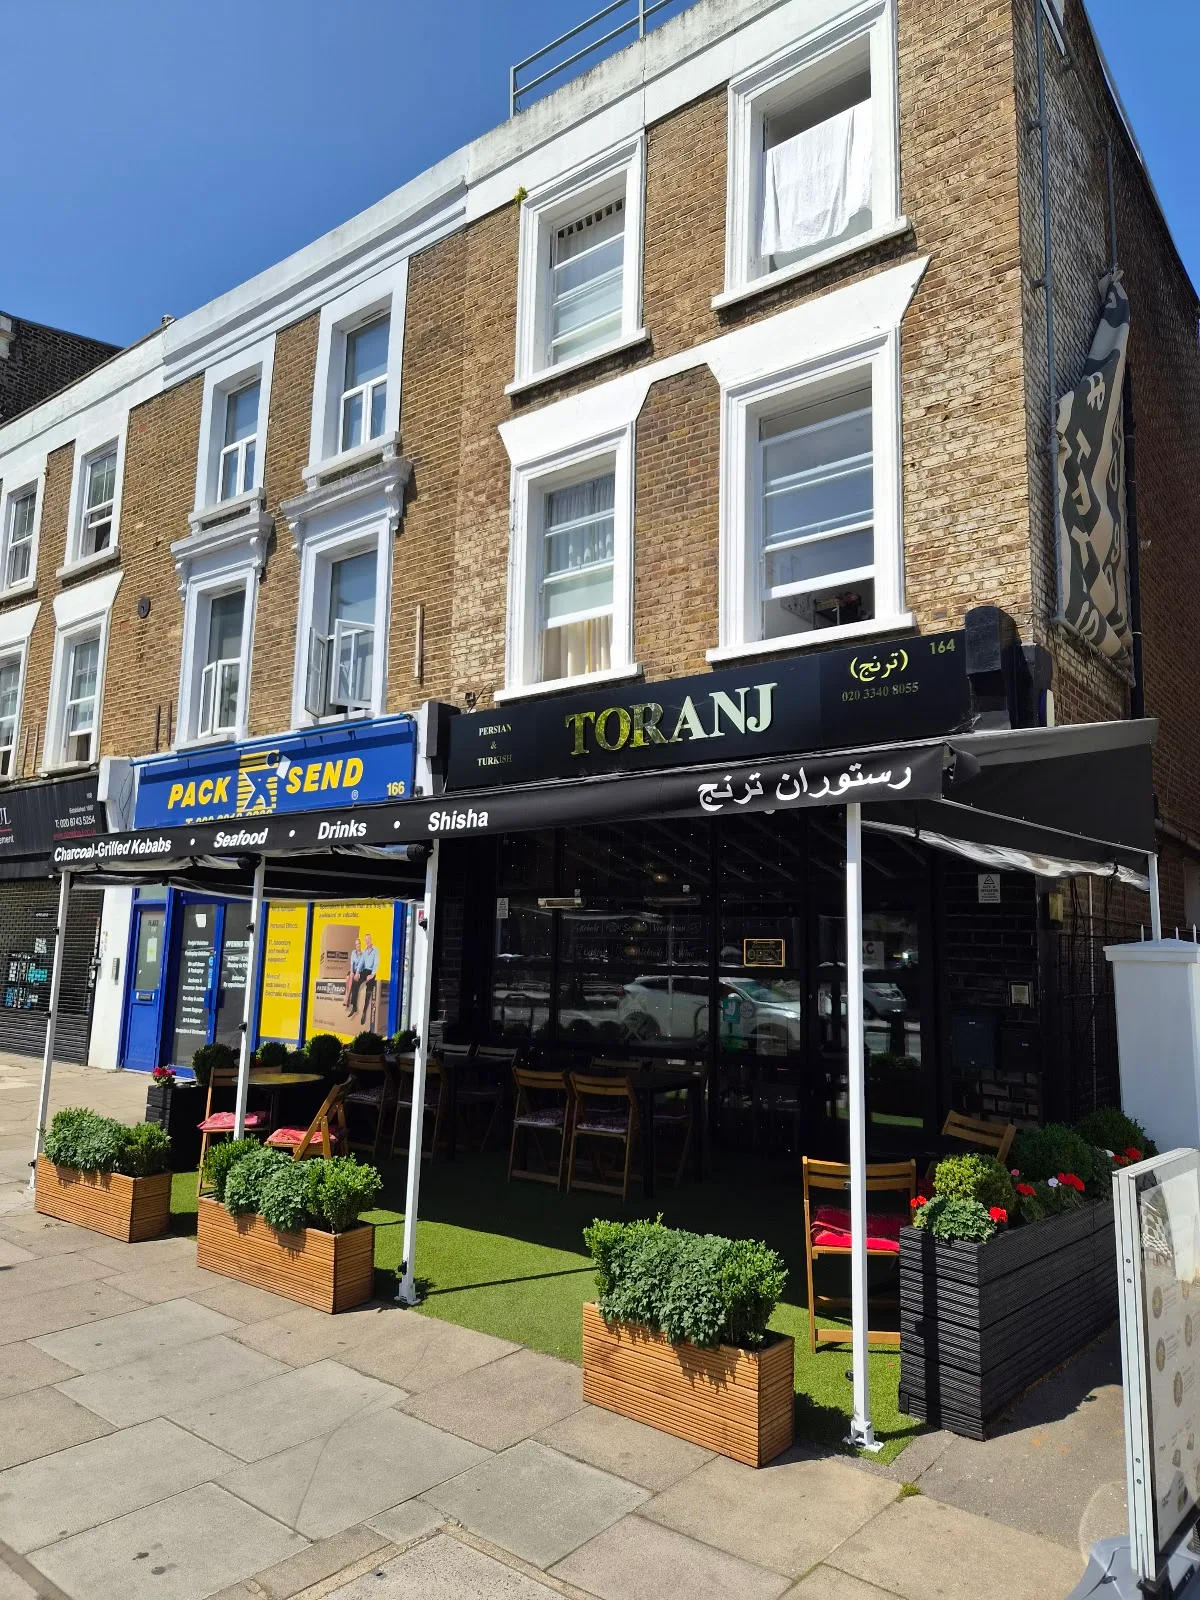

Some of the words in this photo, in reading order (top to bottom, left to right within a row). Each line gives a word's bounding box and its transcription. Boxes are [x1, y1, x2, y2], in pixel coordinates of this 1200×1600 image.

[929, 638, 956, 655] 164
[849, 648, 909, 683] (ترنج)
[841, 690, 861, 702] 020
[863, 686, 889, 700] 3340
[892, 681, 919, 695] 8055
[563, 682, 778, 756] TORANJ
[478, 723, 512, 736] PERSIAN
[490, 740, 497, 749] &
[477, 754, 512, 767] TURKISH
[167, 776, 231, 810] PACK
[285, 757, 364, 794] SEND
[386, 781, 406, 797] 166
[697, 773, 764, 812] ترنج
[775, 765, 913, 802] رستوران
[60, 818, 70, 828] 020
[83, 815, 96, 826] 5254
[54, 840, 131, 862] Charcoal-Grilled
[131, 836, 172, 855] Kebabs
[213, 828, 268, 849] Seafood
[317, 819, 367, 841] Drinks
[427, 805, 489, 832] Shisha
[748, 949, 781, 962] OPEN
